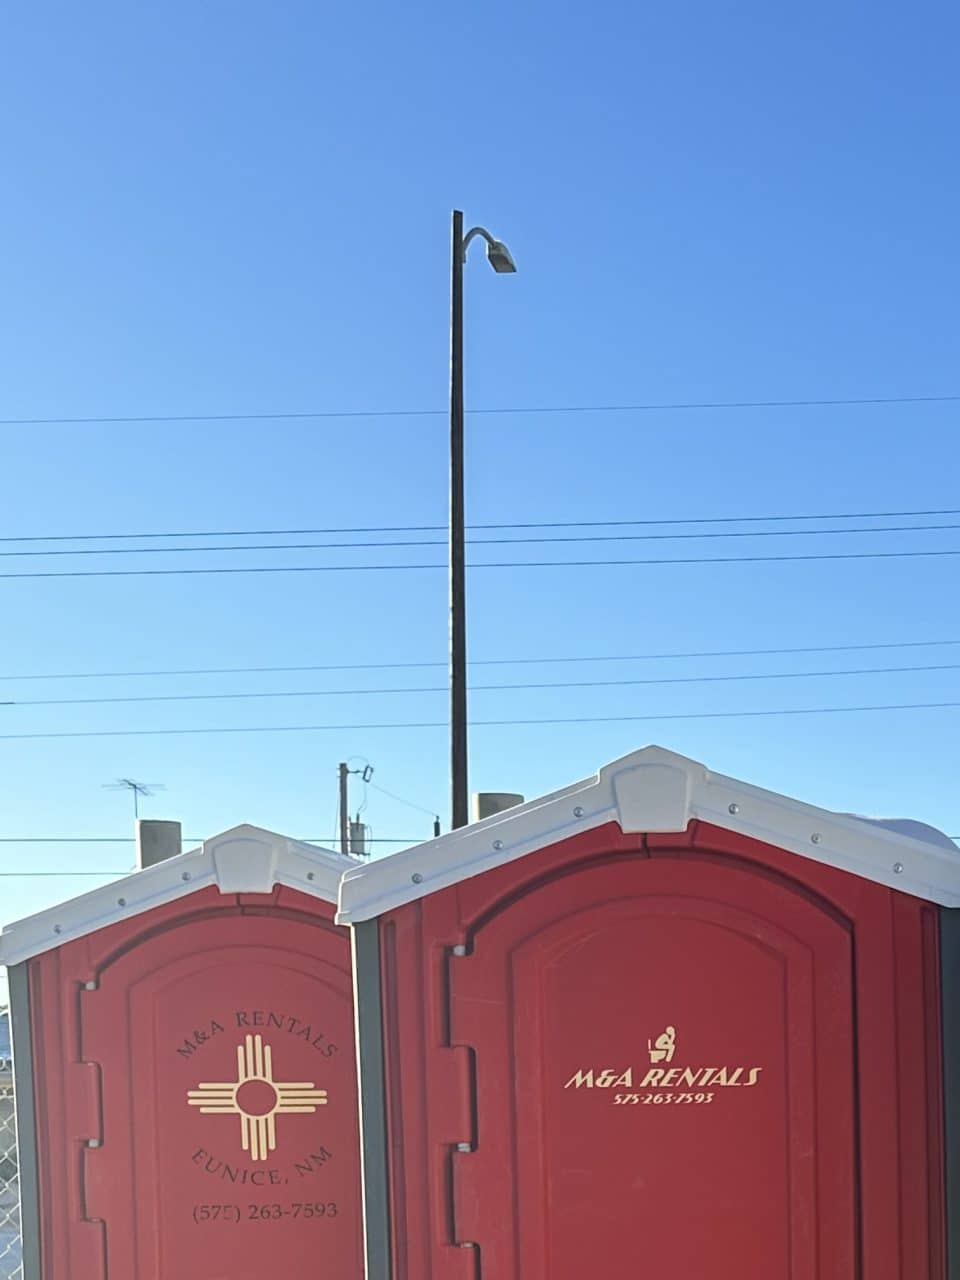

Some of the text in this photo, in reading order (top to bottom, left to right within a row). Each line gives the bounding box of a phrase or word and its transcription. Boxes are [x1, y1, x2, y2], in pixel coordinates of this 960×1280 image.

[177, 1010, 338, 1059] M&A RENTALS
[564, 1066, 762, 1088] M&A RENTALS
[613, 1092, 714, 1105] 575-263-7593
[192, 1146, 333, 1186] EUNICE, NM
[248, 1202, 338, 1220] 263-7593
